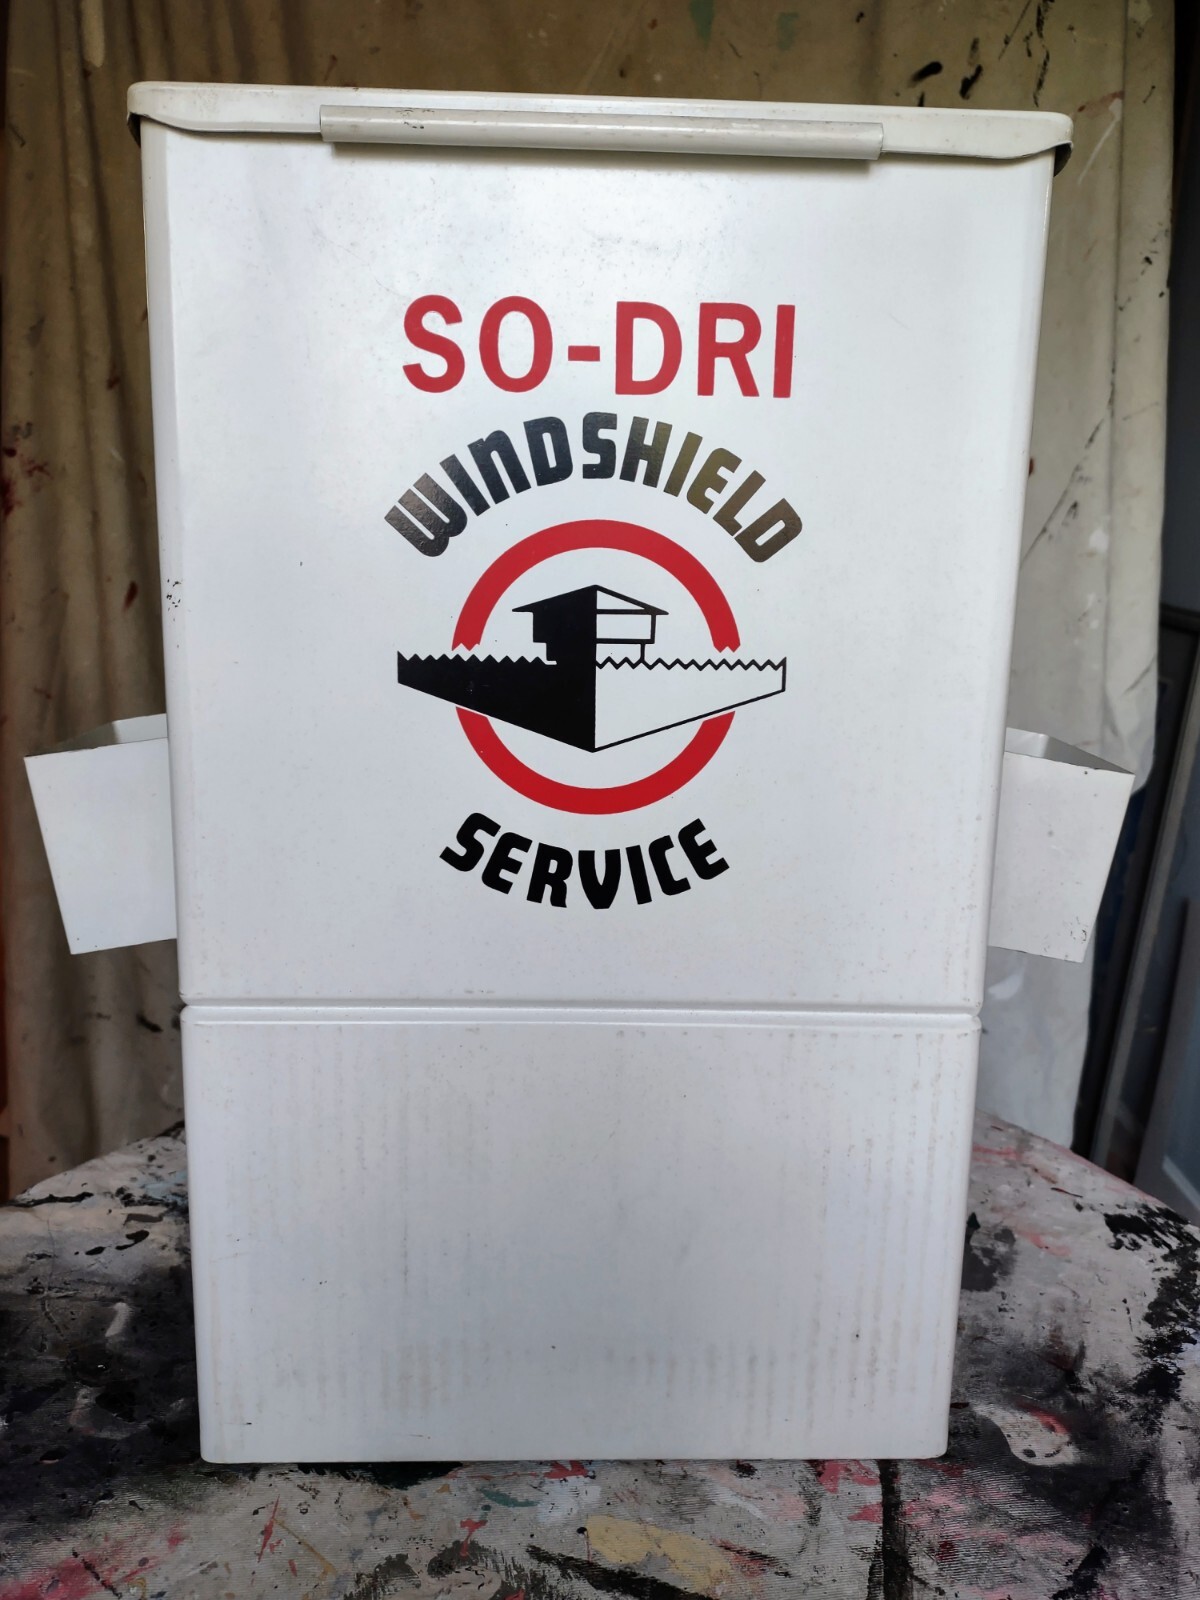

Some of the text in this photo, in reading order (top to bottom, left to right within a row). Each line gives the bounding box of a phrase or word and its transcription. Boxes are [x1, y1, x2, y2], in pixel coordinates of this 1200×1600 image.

[403, 294, 796, 399] SO-DRI
[384, 411, 803, 563] WINDSHIELD
[438, 812, 731, 910] SERVICE
